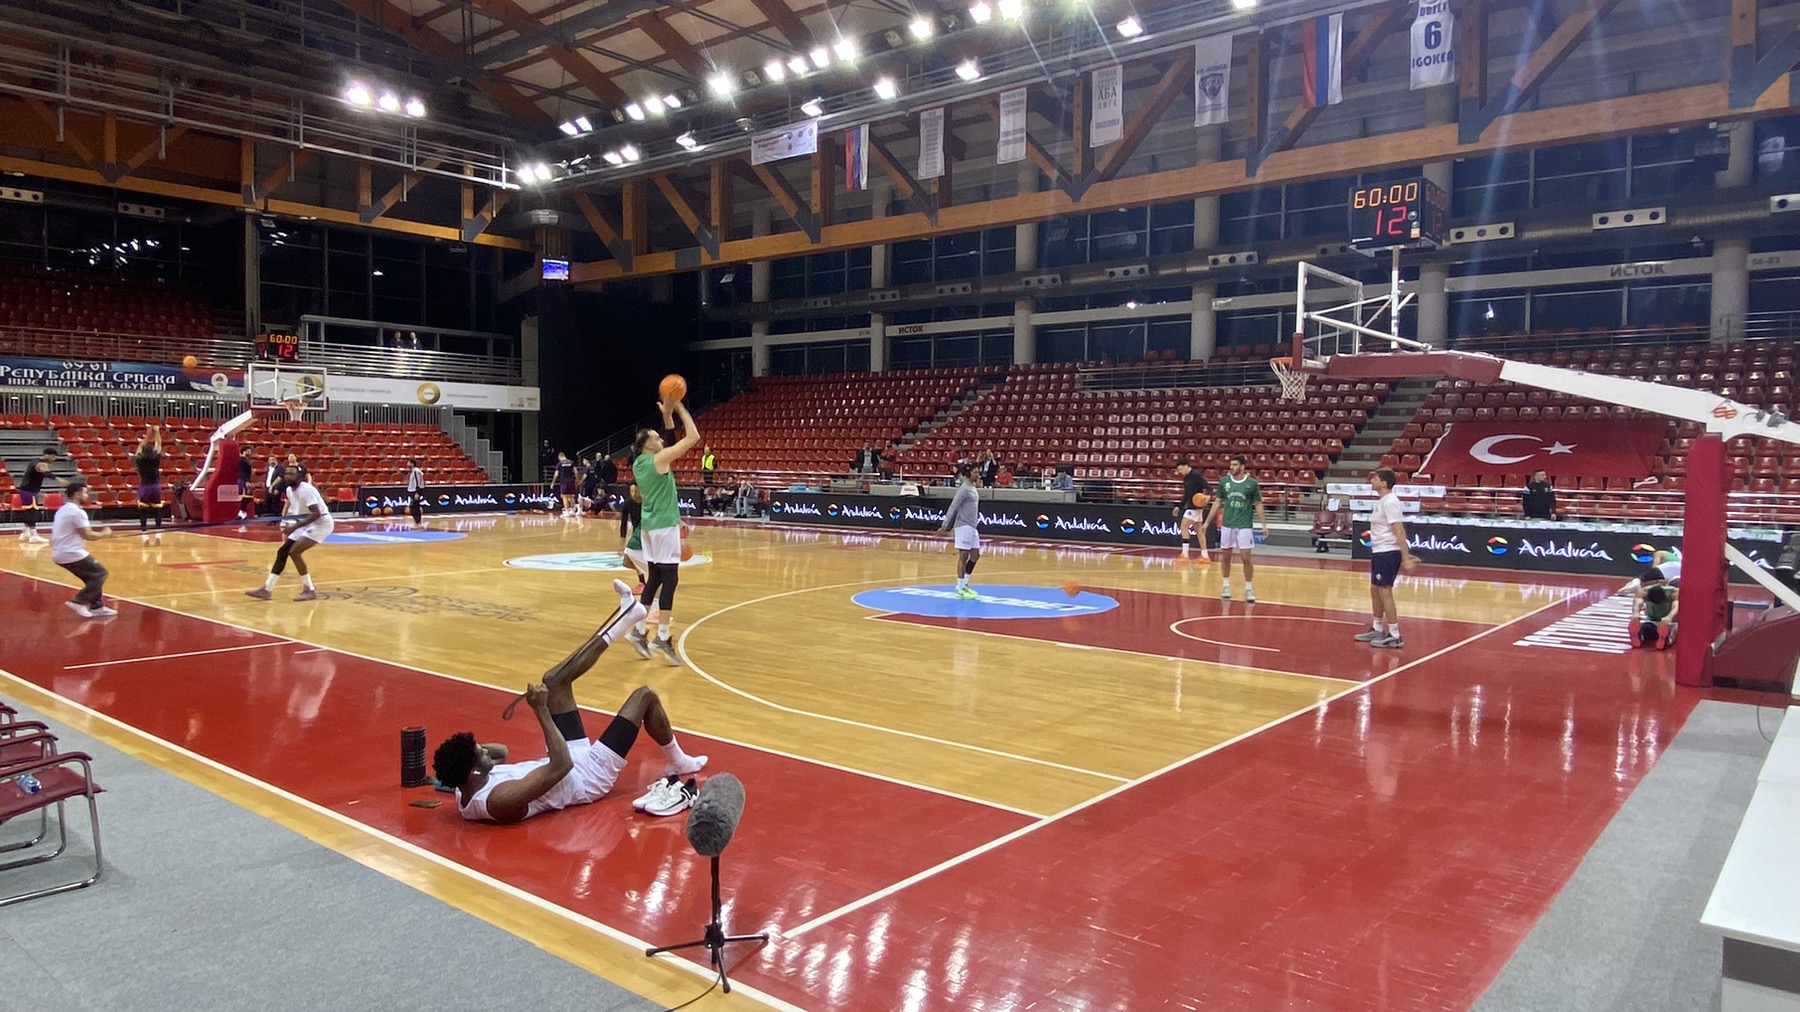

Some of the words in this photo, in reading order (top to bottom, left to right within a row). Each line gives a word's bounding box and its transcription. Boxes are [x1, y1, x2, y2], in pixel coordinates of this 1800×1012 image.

[1425, 21, 1441, 49] 6
[1412, 51, 1453, 68] IGOKEA
[1354, 182, 1418, 209] 60:00
[1375, 206, 1407, 236] 12
[1610, 264, 1666, 277] ИСТОК
[269, 334, 298, 344] 60:00
[278, 345, 293, 356] 12
[383, 496, 431, 507] Andalía
[783, 502, 822, 516] Andalucía
[841, 505, 883, 519] Andalucía
[1054, 516, 1111, 533] Andalucía
[1405, 533, 1471, 553] ndalucía
[1518, 538, 1614, 561] Andalucía
